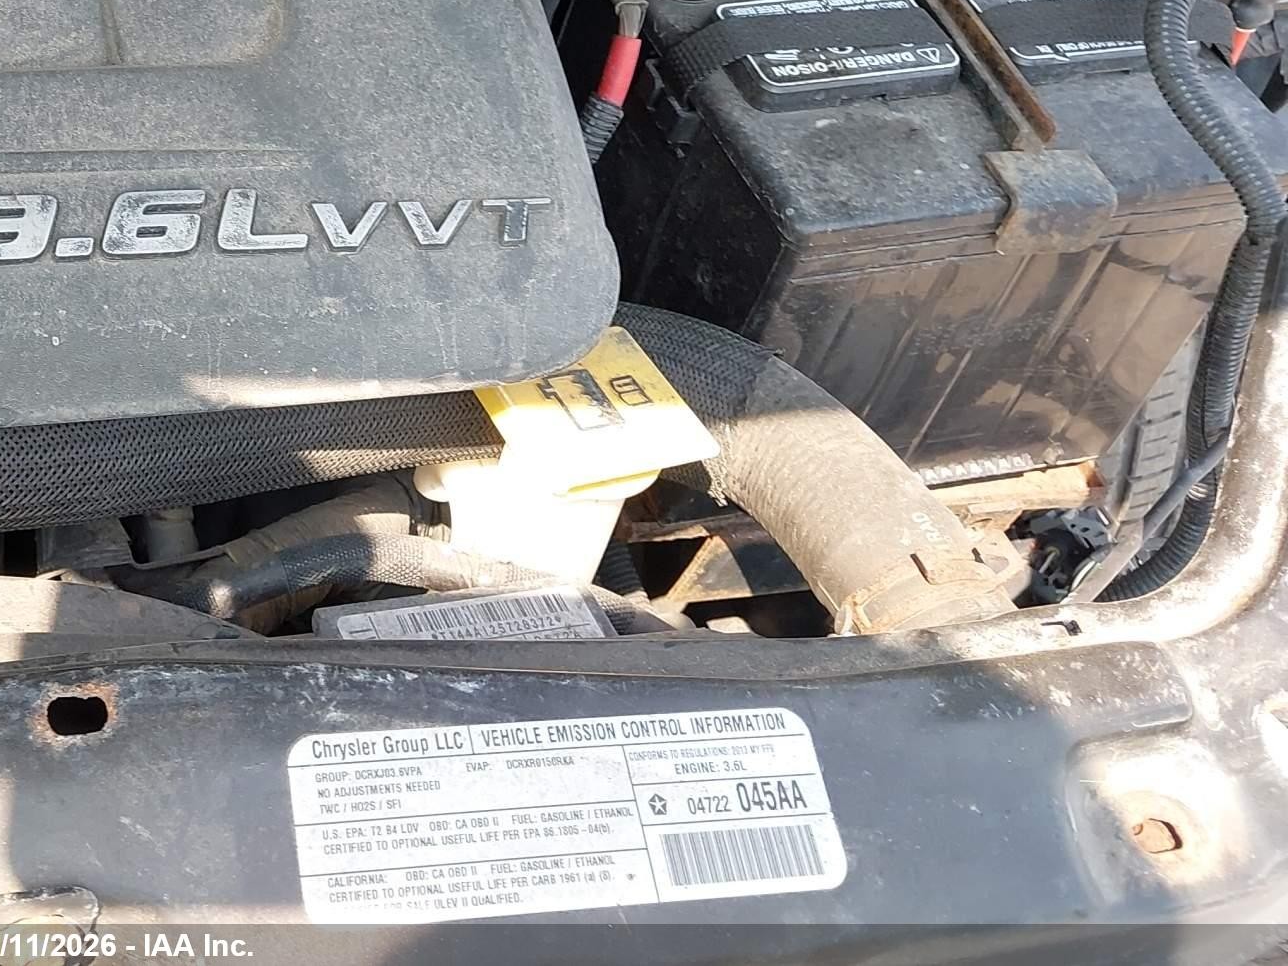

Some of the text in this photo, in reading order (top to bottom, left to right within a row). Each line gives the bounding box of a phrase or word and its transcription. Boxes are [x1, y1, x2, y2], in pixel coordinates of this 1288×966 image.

[480, 712, 786, 747] VEHICLE EMISSION CONTROL INFORMATION
[312, 731, 464, 761] Chrysler Group LLC
[669, 748, 679, 760] TO
[315, 771, 351, 783] GROUP:
[465, 761, 493, 773] EVAP:
[674, 759, 748, 775] ENGINE: 3.6L
[317, 779, 441, 799] NO ADJUSTMENTS NEEDED
[687, 779, 808, 816] 04722 045AA
[320, 803, 340, 815] TWC
[386, 797, 402, 810] SFI
[322, 829, 342, 841] U.S.
[345, 827, 368, 840] EPA:
[370, 825, 382, 837] T2
[400, 822, 419, 835] LDV
[429, 820, 451, 832] OBD:
[455, 819, 468, 831] CA
[470, 817, 490, 829] OBD
[511, 814, 538, 826] FUEL:
[540, 809, 585, 824] GASOLINE
[593, 806, 634, 820] ETHANOL
[323, 841, 373, 856] CERTIFIED
[375, 840, 389, 852] TO
[391, 835, 438, 850] OPTIONAL
[441, 832, 477, 846] USEFUL
[479, 830, 500, 843] LIFE
[502, 828, 520, 841] PER
[523, 827, 541, 839] EPA
[327, 873, 388, 889] CALIFORNIA:
[405, 869, 429, 882] OBD:
[431, 868, 445, 880] CA
[448, 866, 468, 879] OBD
[490, 863, 518, 876] FUEL:
[520, 858, 565, 873] GASOLINE
[575, 854, 616, 870] ETHANOL
[329, 889, 378, 903] CERTIFIED
[382, 887, 395, 899] TO
[398, 883, 444, 898] OPTIONAL
[448, 880, 483, 894] USEFUL
[487, 877, 508, 891] LIFE
[510, 876, 529, 888] PER
[531, 873, 557, 887] CARB
[559, 871, 582, 884] 1961
[433, 897, 458, 910] ULEV
[471, 891, 524, 907] QUALIFIED.
